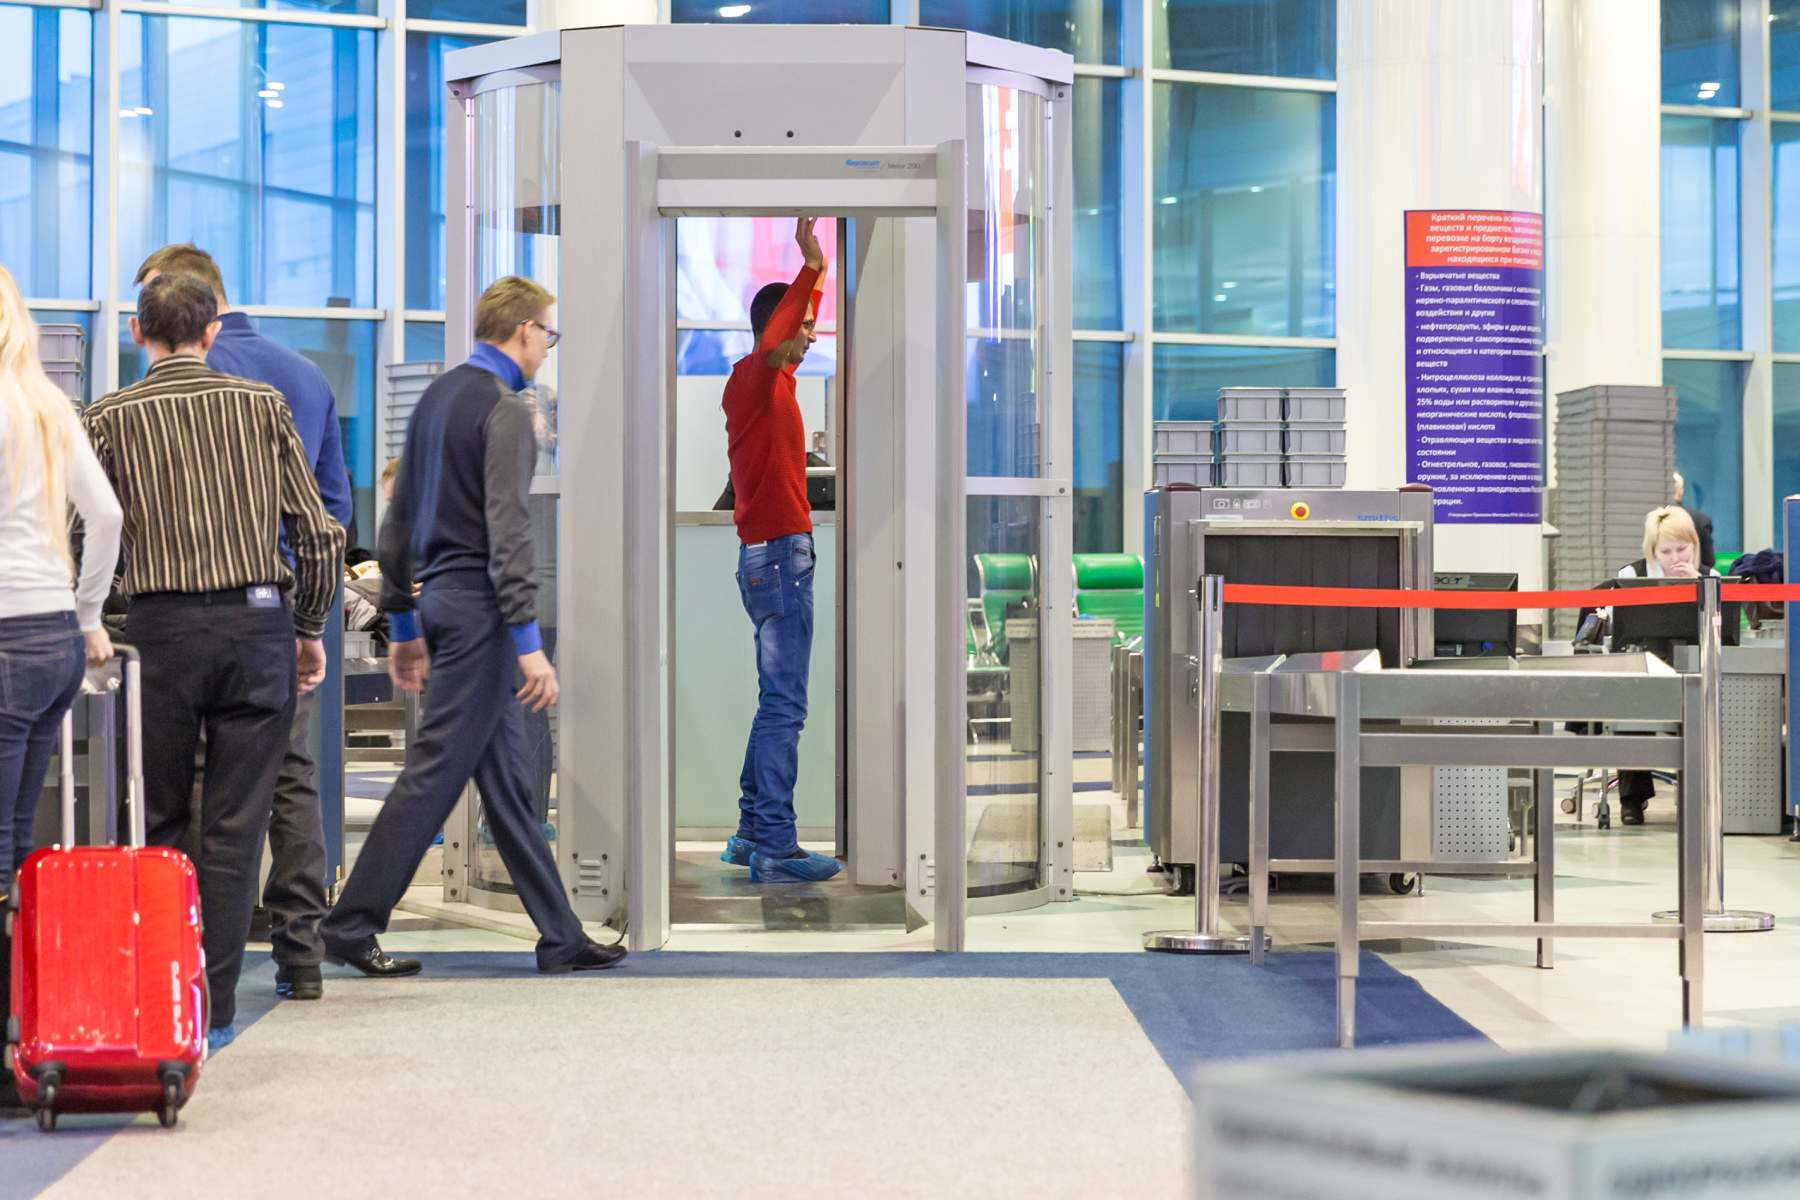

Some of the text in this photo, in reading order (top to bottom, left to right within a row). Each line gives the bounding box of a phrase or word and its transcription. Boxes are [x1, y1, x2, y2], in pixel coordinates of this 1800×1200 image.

[1431, 213, 1466, 223] Краткий
[1467, 215, 1503, 223] перечень
[1429, 225, 1465, 233] веществ
[1425, 235, 1469, 243] перевозке
[1447, 256, 1499, 264] находящихся
[1420, 272, 1466, 280] Взрывчатые
[1467, 273, 1500, 281] вещества
[1420, 284, 1441, 293] Газы,
[1415, 297, 1505, 305] нервно-паралитического
[1415, 308, 1464, 317] воздействия
[1470, 310, 1495, 318] другие
[1420, 323, 1481, 331] нефтепродукты,
[1416, 336, 1474, 344] подверженные
[1422, 348, 1472, 356] относящиеся
[1416, 360, 1448, 368] веществ
[1420, 373, 1485, 382] Нитроцеллюлоза
[1450, 387, 1471, 395] сухая
[1416, 398, 1432, 406] 25%
[1433, 399, 1454, 407] воды
[1416, 411, 1477, 419] неорганические
[1416, 423, 1466, 432] (плавиковая)
[1420, 436, 1475, 445] Отравляющие
[1421, 460, 1481, 469] Огнестрельное,
[1417, 474, 1448, 482] оружие,
[1433, 498, 1464, 506] ерации.
